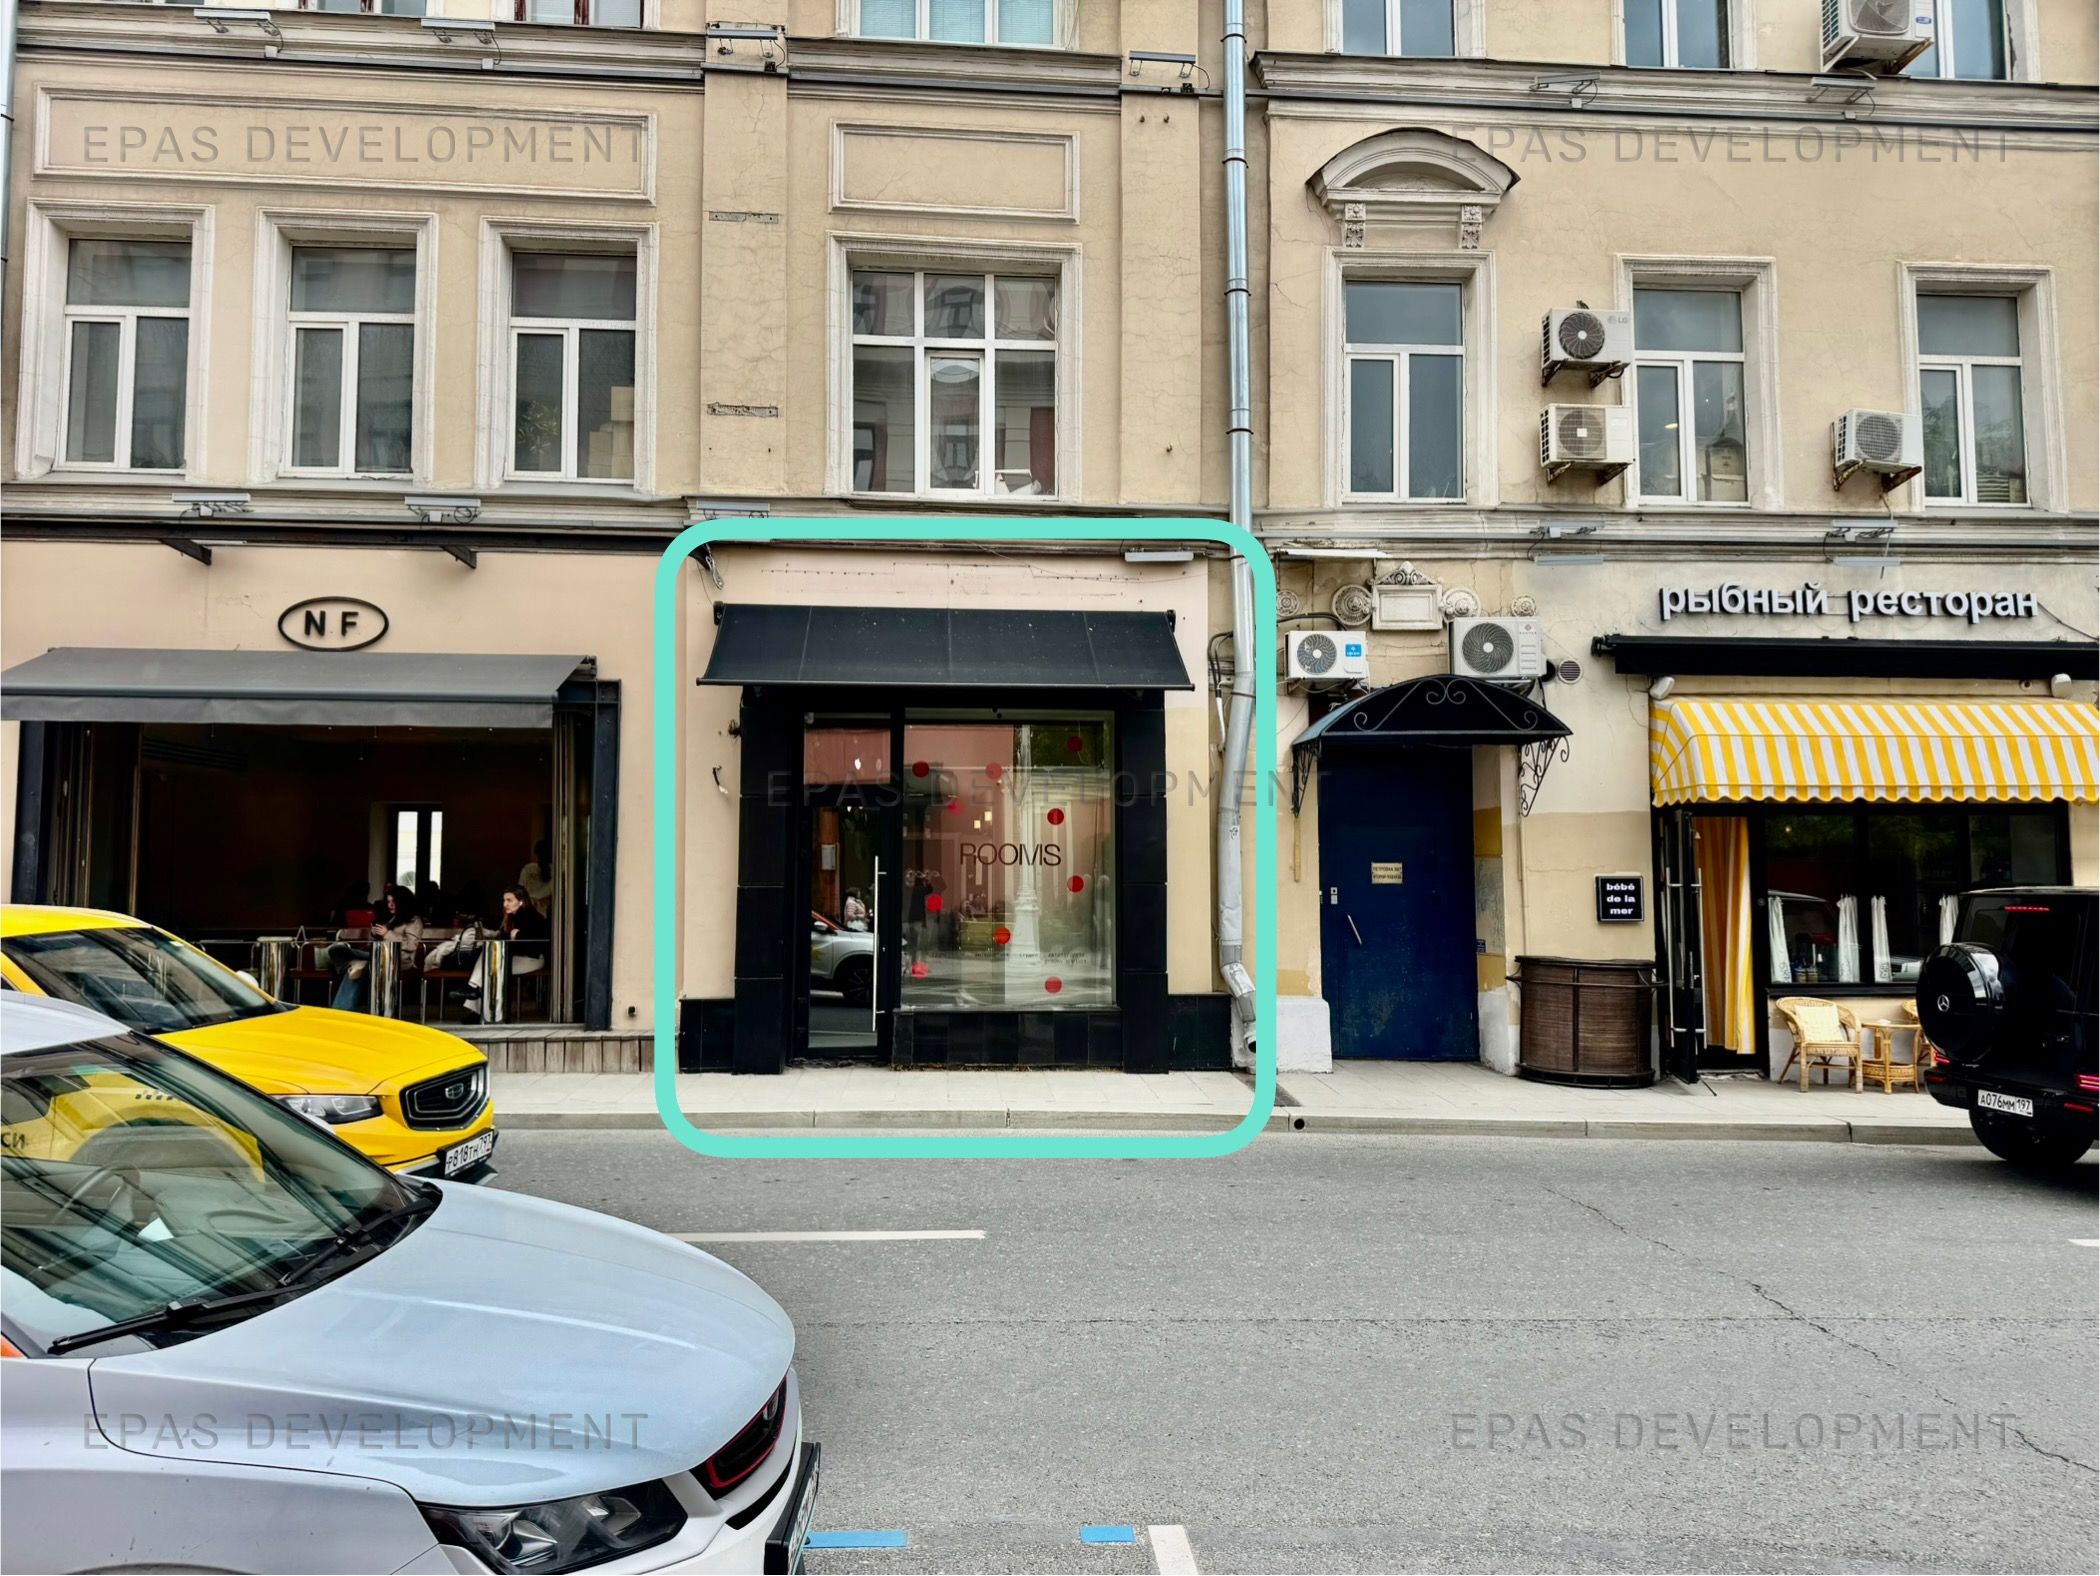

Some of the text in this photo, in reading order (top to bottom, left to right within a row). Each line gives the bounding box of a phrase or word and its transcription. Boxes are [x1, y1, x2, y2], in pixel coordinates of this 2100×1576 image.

[1659, 581, 2039, 624] рыбный ресторан
[960, 842, 1062, 866] ROOMS
[1606, 882, 1636, 891] bébé
[1606, 894, 1636, 903] de la
